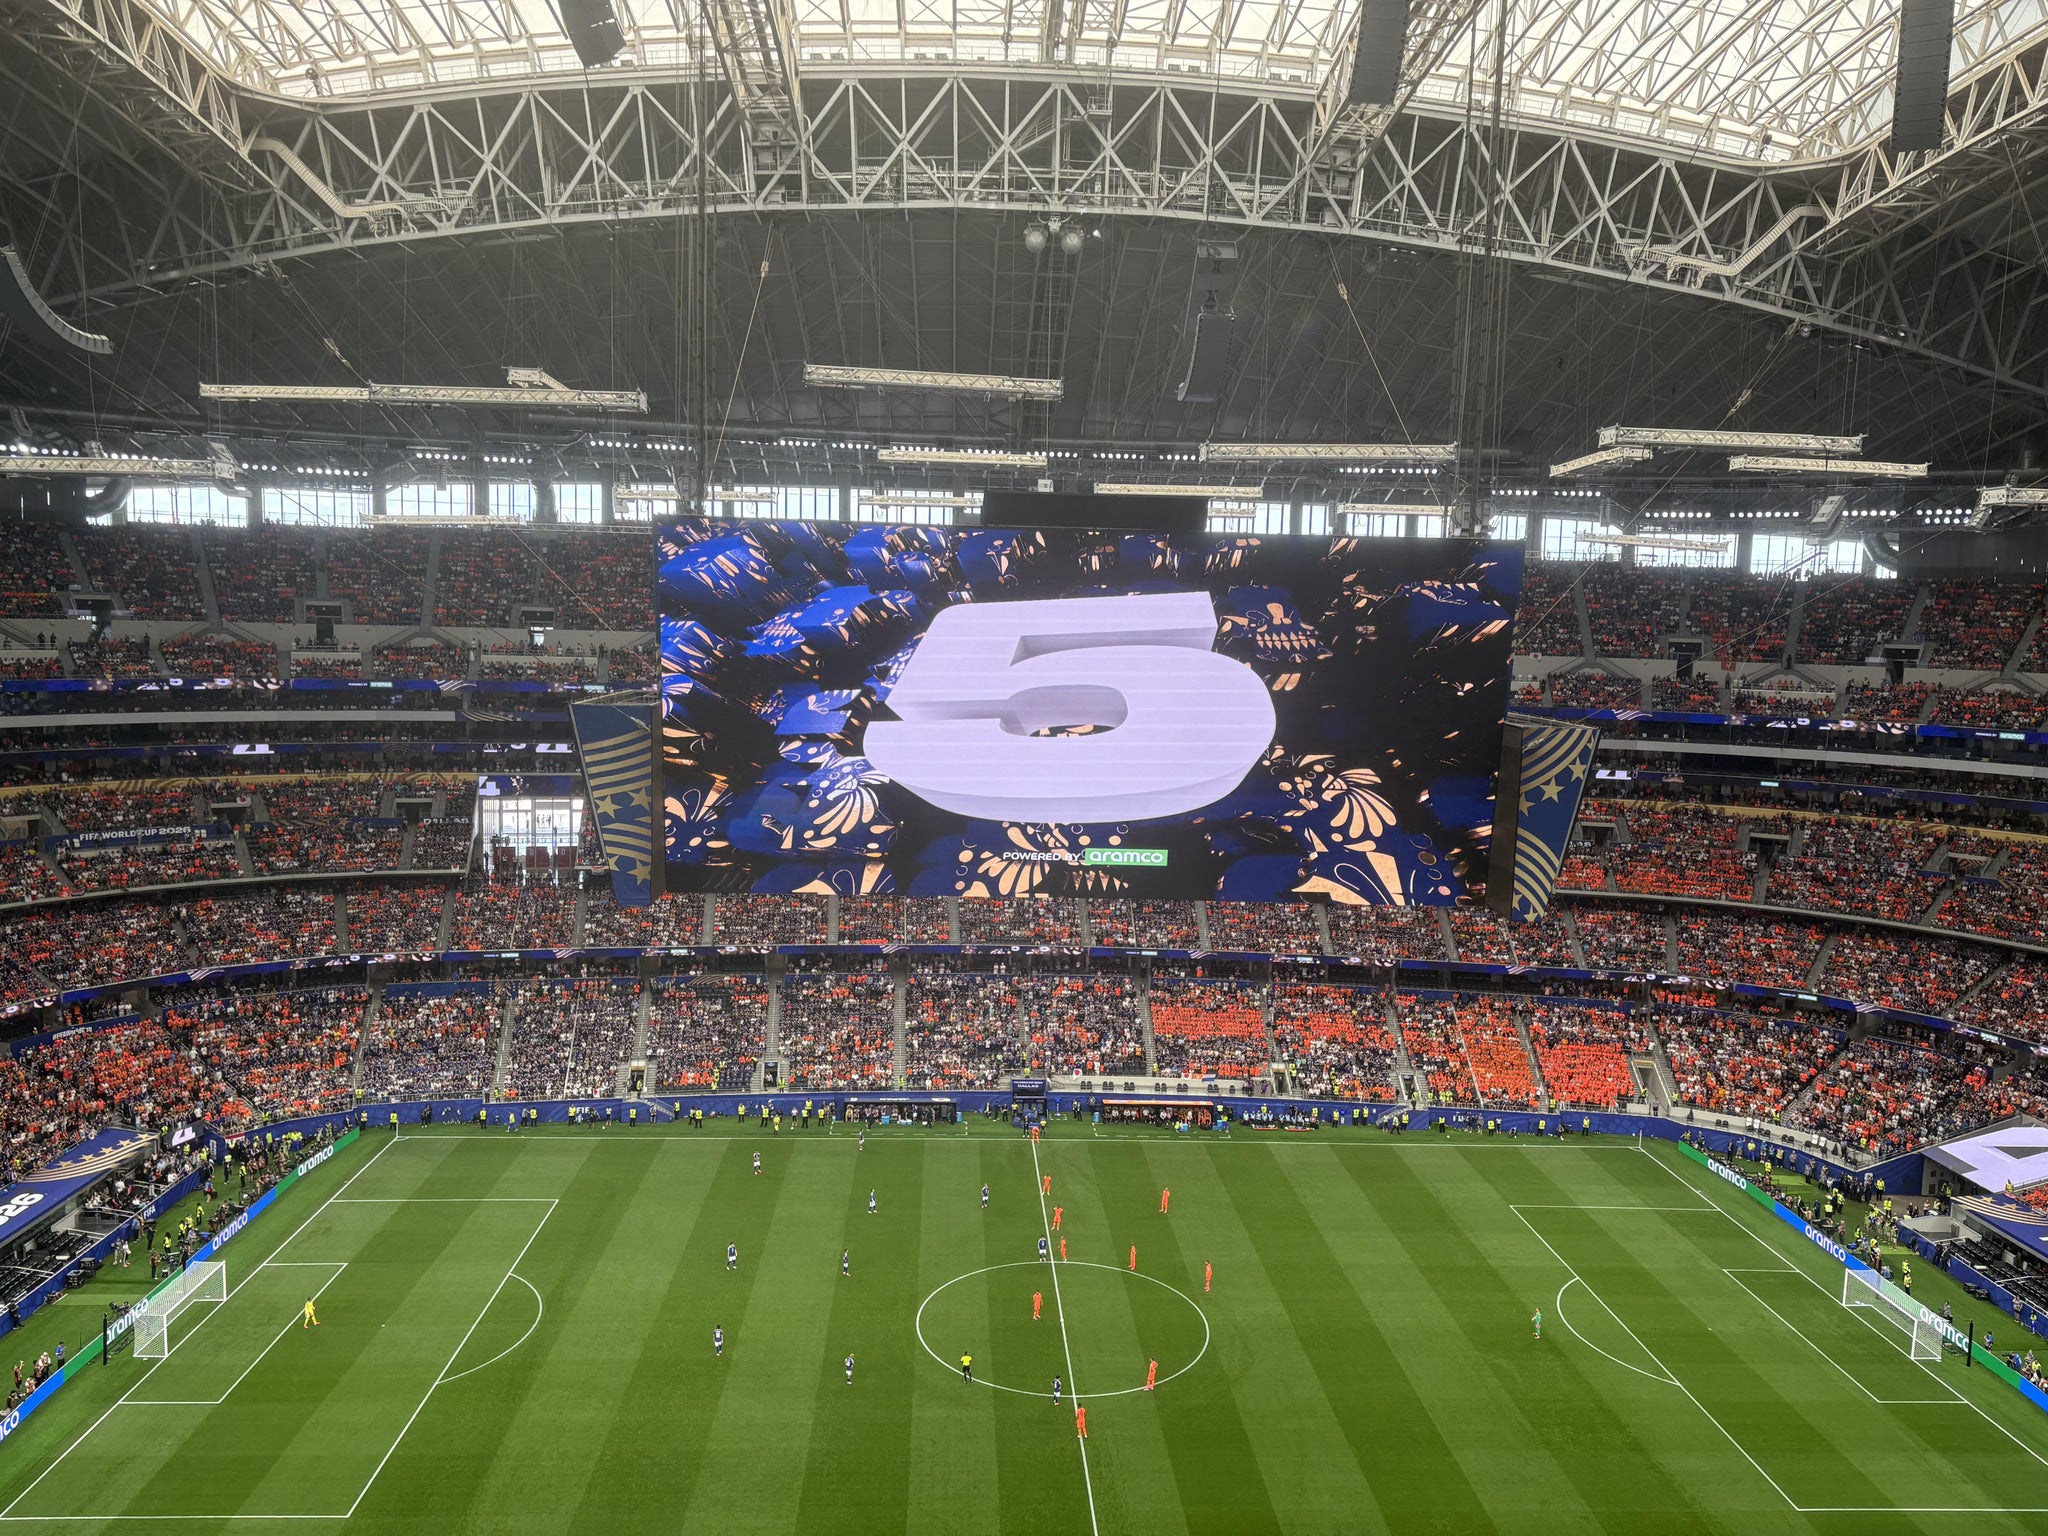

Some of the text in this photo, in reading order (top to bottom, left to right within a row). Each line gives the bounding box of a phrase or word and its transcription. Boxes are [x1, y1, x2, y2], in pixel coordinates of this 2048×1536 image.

[863, 591, 1277, 823] 5
[102, 829, 137, 839] WORLD
[159, 826, 191, 835] 2026
[1003, 852, 1081, 862] POWERED BY
[1089, 851, 1163, 863] aramco
[576, 1106, 590, 1114] FIF
[298, 1145, 334, 1177] aramco
[1707, 1158, 1747, 1190] aramco
[143, 1204, 156, 1220] FIFA
[212, 1212, 248, 1251] aramco
[1805, 1225, 1846, 1262] aramco
